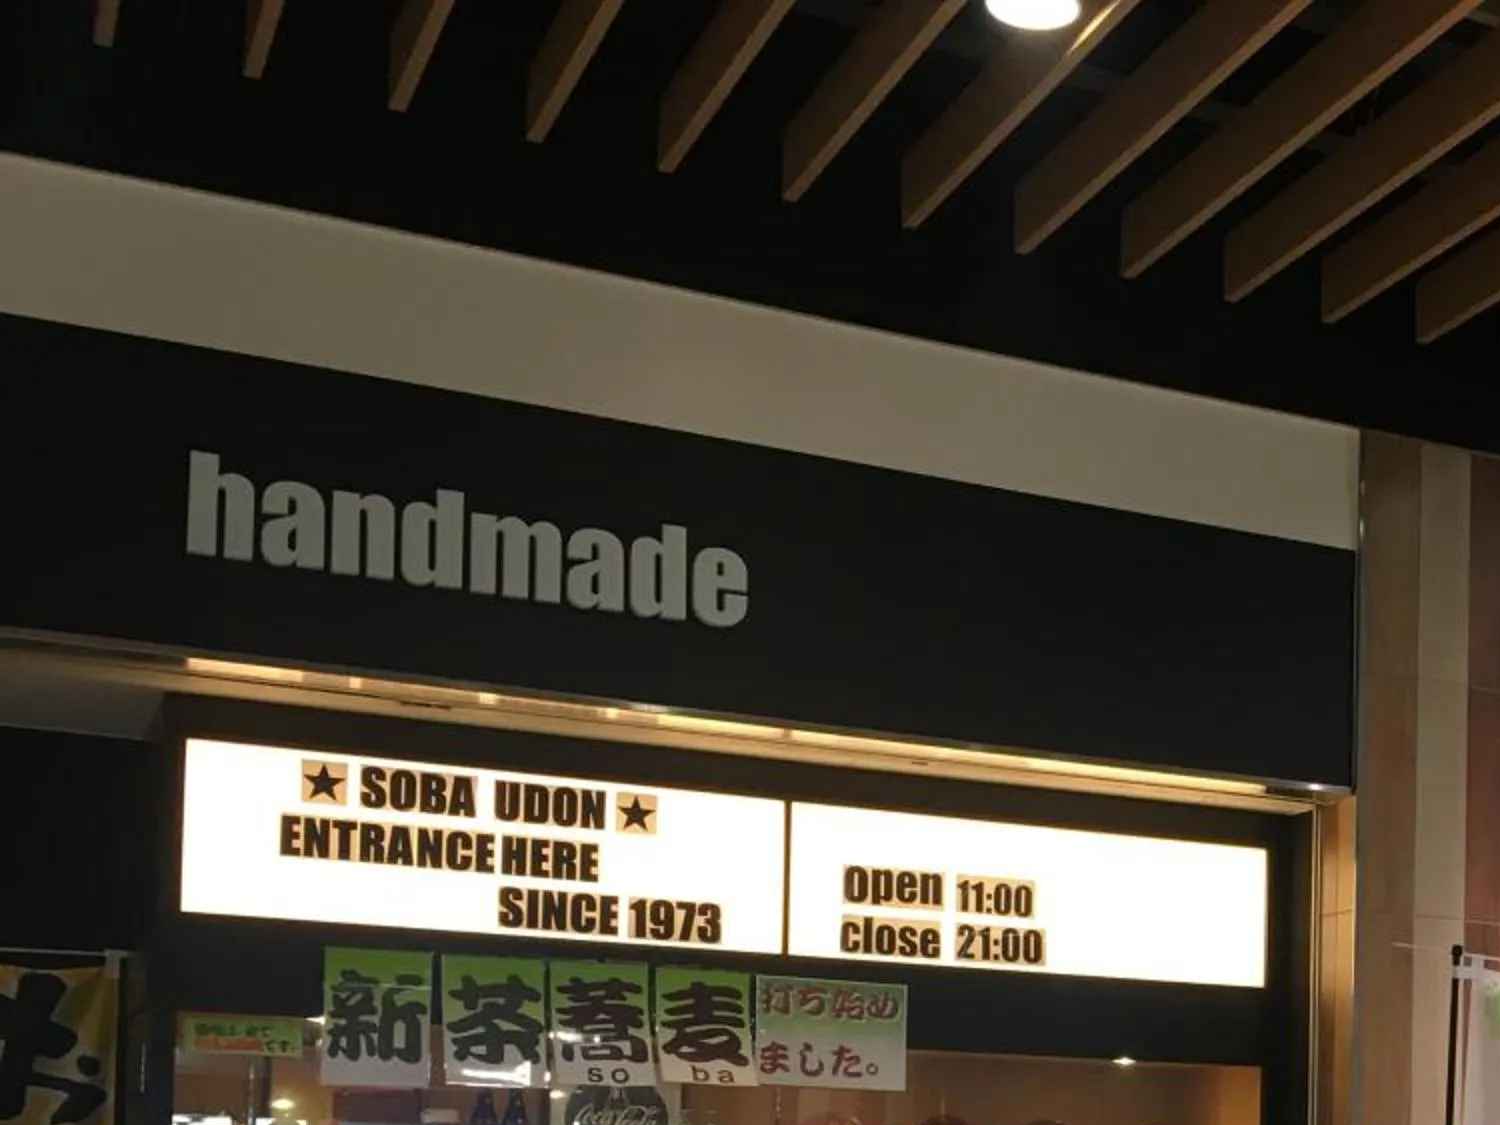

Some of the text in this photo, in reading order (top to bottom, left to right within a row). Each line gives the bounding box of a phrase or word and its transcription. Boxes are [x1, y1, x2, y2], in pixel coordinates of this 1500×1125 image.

[187, 449, 749, 628] handmade
[360, 764, 606, 830] SOBA UDON
[279, 814, 600, 883] ENTRANCE HERE
[497, 886, 722, 945] SINCE 1973
[957, 879, 1033, 918] 11:00
[840, 916, 1043, 963] close 21:00
[760, 983, 899, 1022] 打ち始め
[587, 1065, 735, 1085] so ba
[759, 1041, 880, 1079] ました。
